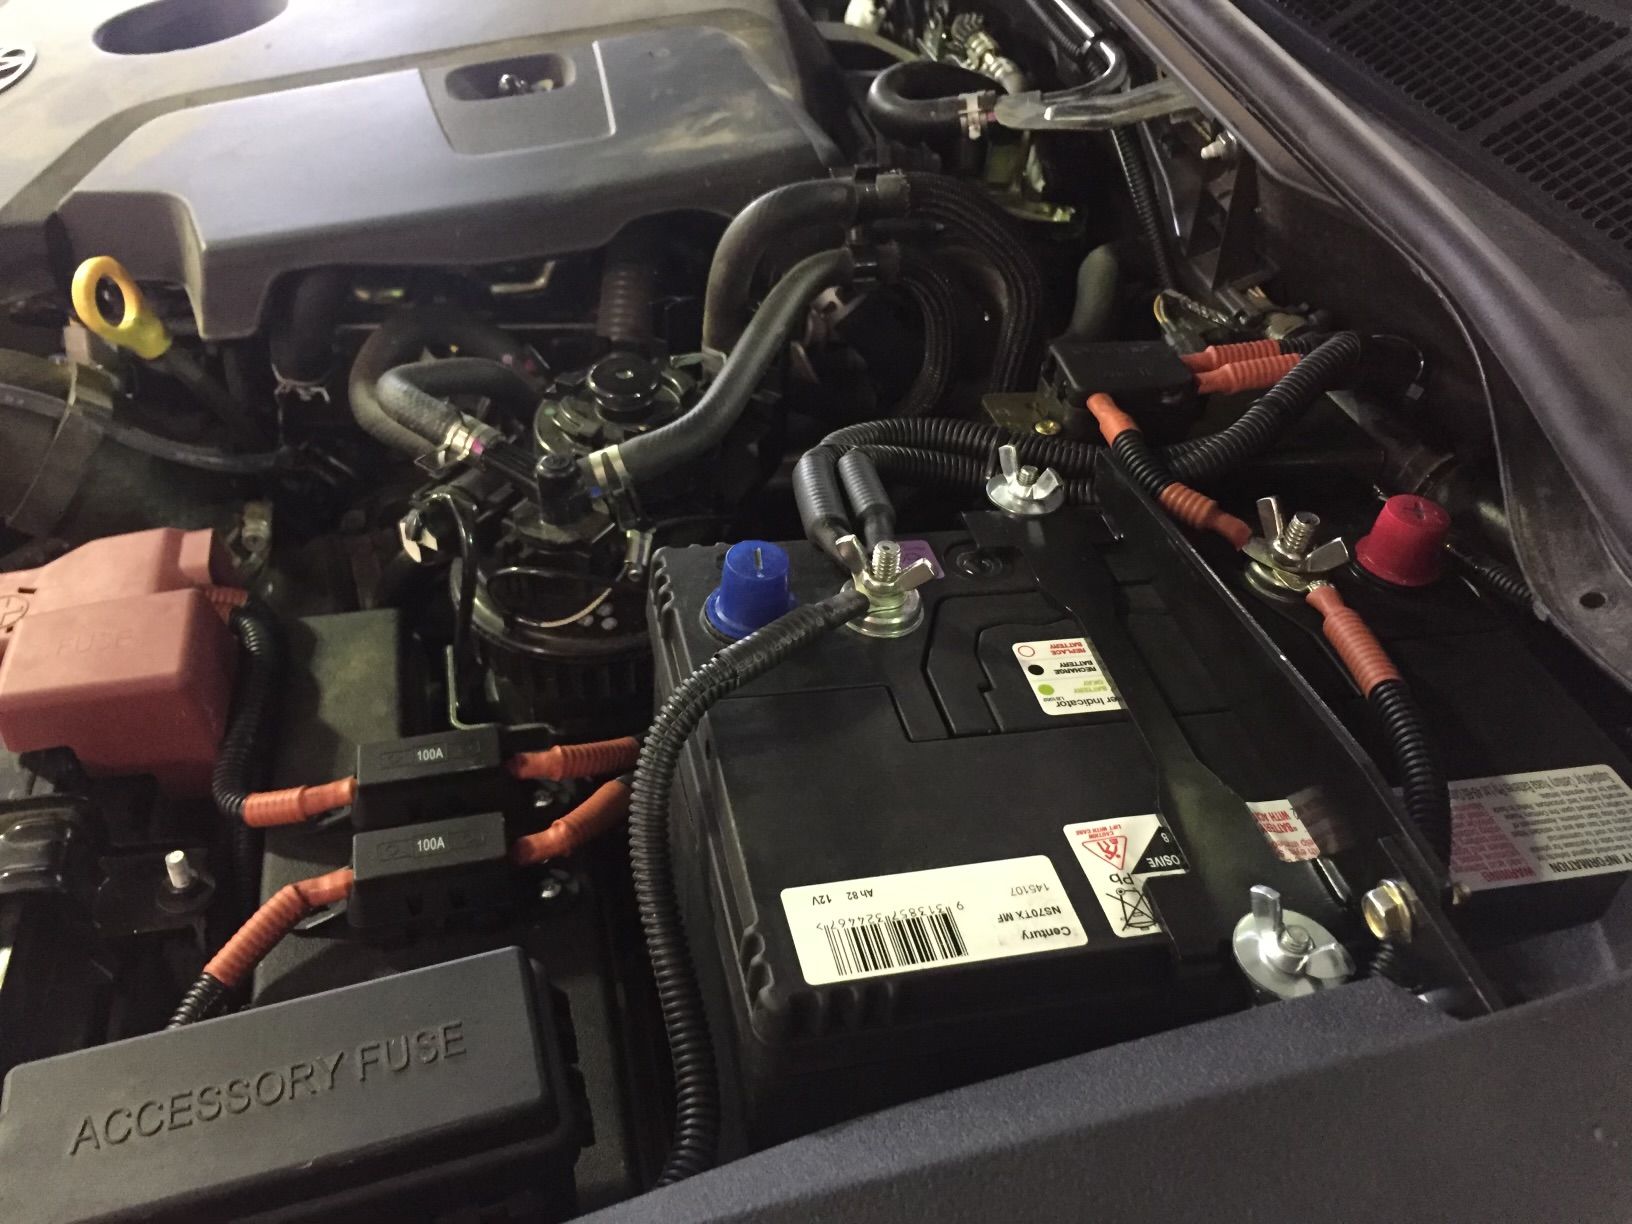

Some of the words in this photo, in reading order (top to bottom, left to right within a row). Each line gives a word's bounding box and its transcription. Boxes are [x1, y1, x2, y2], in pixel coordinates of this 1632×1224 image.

[1054, 666, 1097, 674] RECHARGE
[1056, 697, 1105, 708] Indicator
[417, 748, 443, 761] 100A
[417, 837, 445, 852] 100A
[1548, 855, 1622, 873] INFORMATION
[1109, 873, 1135, 885] Pb
[1480, 866, 1537, 882] WARNING
[859, 888, 874, 899] Ah
[1009, 881, 1050, 897] 145107
[811, 893, 832, 905] 12V
[845, 891, 858, 901] 82
[996, 910, 1014, 923] MF
[1014, 905, 1062, 920] NS70TX
[1021, 925, 1072, 942] Century
[70, 1052, 345, 1156] ACCESSORY
[359, 1021, 468, 1082] FUSE
